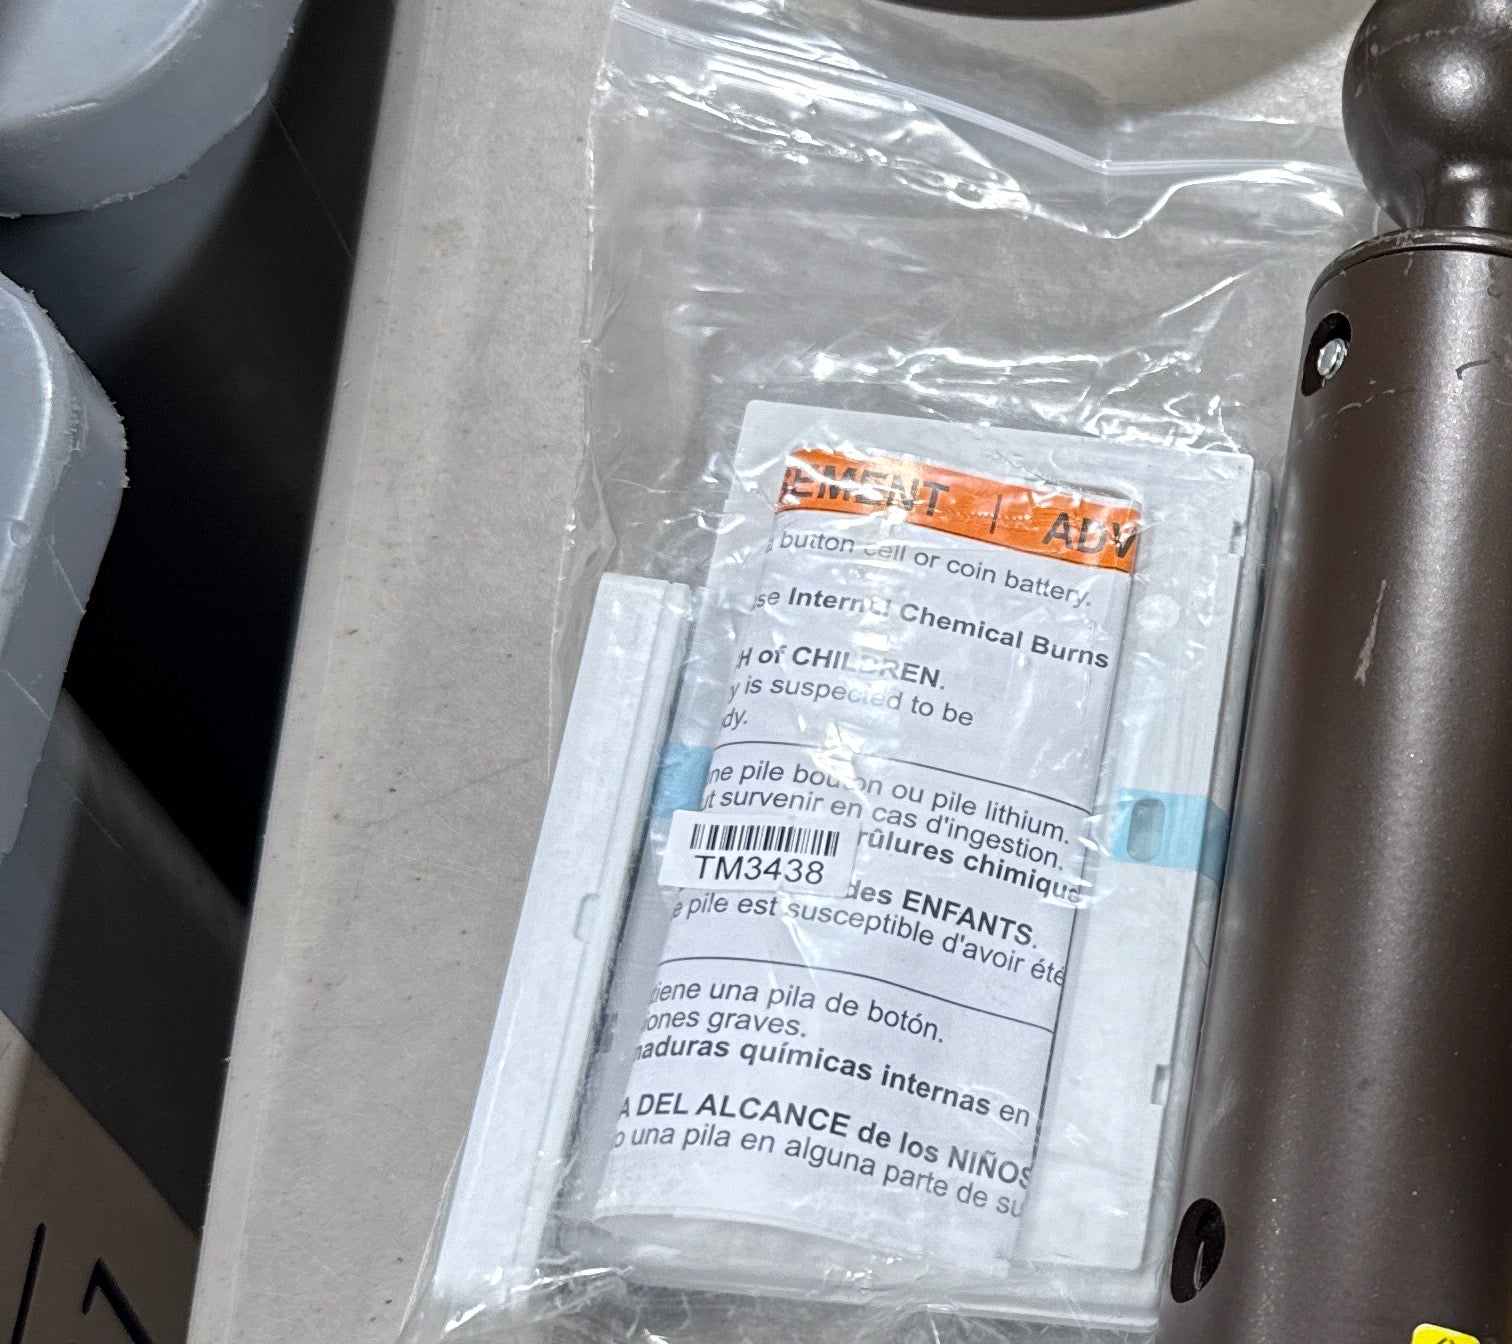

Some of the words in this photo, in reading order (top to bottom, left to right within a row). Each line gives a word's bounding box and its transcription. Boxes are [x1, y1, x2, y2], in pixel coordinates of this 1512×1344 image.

[779, 530, 855, 554] button
[914, 552, 940, 569] or
[946, 556, 996, 584] coin
[1003, 568, 1092, 609] battery.
[752, 591, 781, 611] se
[900, 602, 1023, 650] Chemical
[1030, 635, 1110, 669] Burns
[758, 645, 787, 664] of
[744, 675, 763, 694] is
[910, 695, 935, 717] to
[941, 699, 974, 727] be
[720, 790, 825, 813] survenir
[830, 801, 863, 819] en
[872, 806, 917, 829] cas
[925, 814, 1064, 871] d'ingestion.
[738, 760, 785, 785] pile
[891, 783, 923, 804] ou
[931, 792, 978, 817] pile
[984, 799, 1070, 845] lithium.
[694, 854, 825, 885] TM3438
[686, 893, 729, 920] pile
[737, 896, 778, 916] est
[785, 900, 935, 946] susceptible
[942, 932, 1026, 975] d'avoir
[901, 889, 1038, 950] ENFANTS.
[707, 1010, 808, 1038] graves.
[709, 983, 758, 1002] una
[766, 985, 816, 1010] pila
[825, 991, 859, 1017] de
[867, 999, 945, 1044] botón.
[740, 1041, 873, 1081] químicas
[881, 1064, 991, 1116] internas
[999, 1103, 1031, 1128] en
[636, 1092, 689, 1116] DEL
[694, 1093, 852, 1138] ALCANCE
[858, 1122, 892, 1149] de
[899, 1132, 939, 1164] los
[631, 1125, 675, 1147] una
[682, 1123, 731, 1151] pila
[740, 1130, 776, 1154] en
[784, 1136, 876, 1177] alguna
[882, 1161, 949, 1198] parte
[956, 1181, 989, 1209] de
